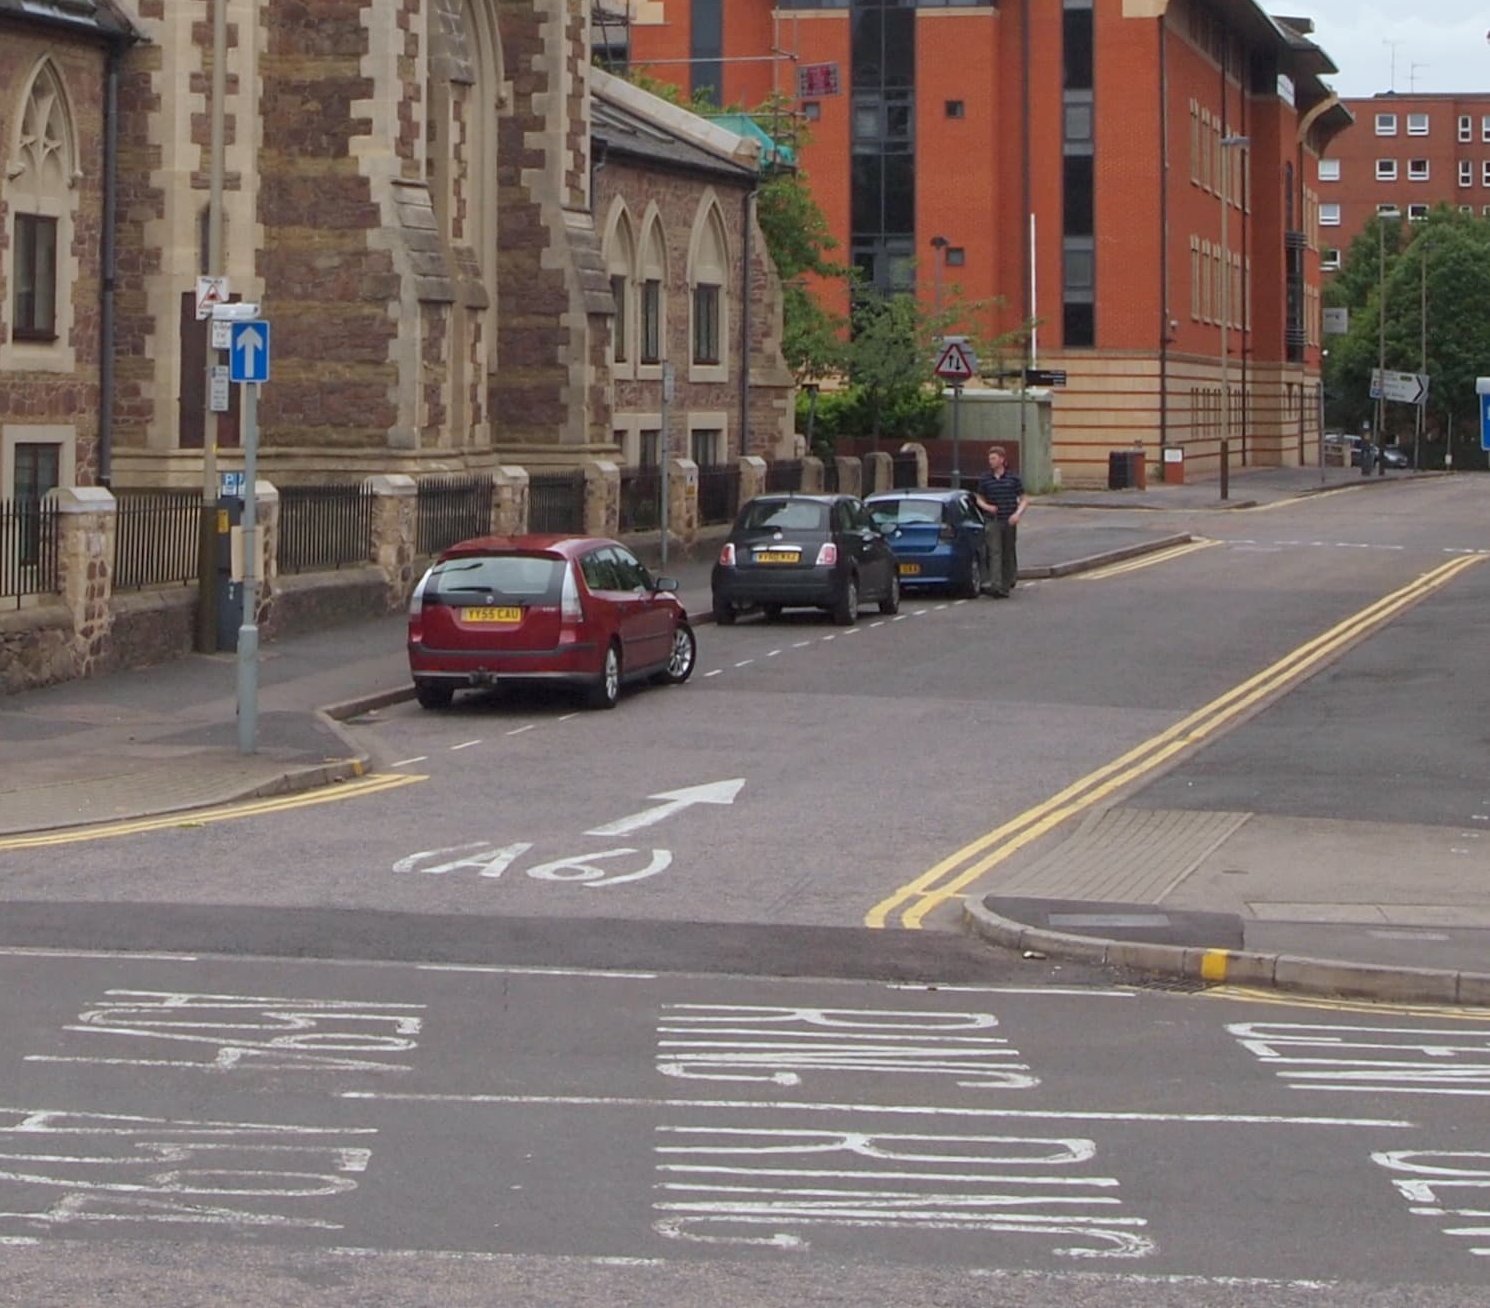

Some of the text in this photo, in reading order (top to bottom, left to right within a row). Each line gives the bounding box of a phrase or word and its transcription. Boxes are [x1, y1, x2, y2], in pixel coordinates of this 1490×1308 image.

[392, 842, 672, 887] (A6)
[656, 1004, 1039, 1088] RING
[652, 1126, 1156, 1259] RING
